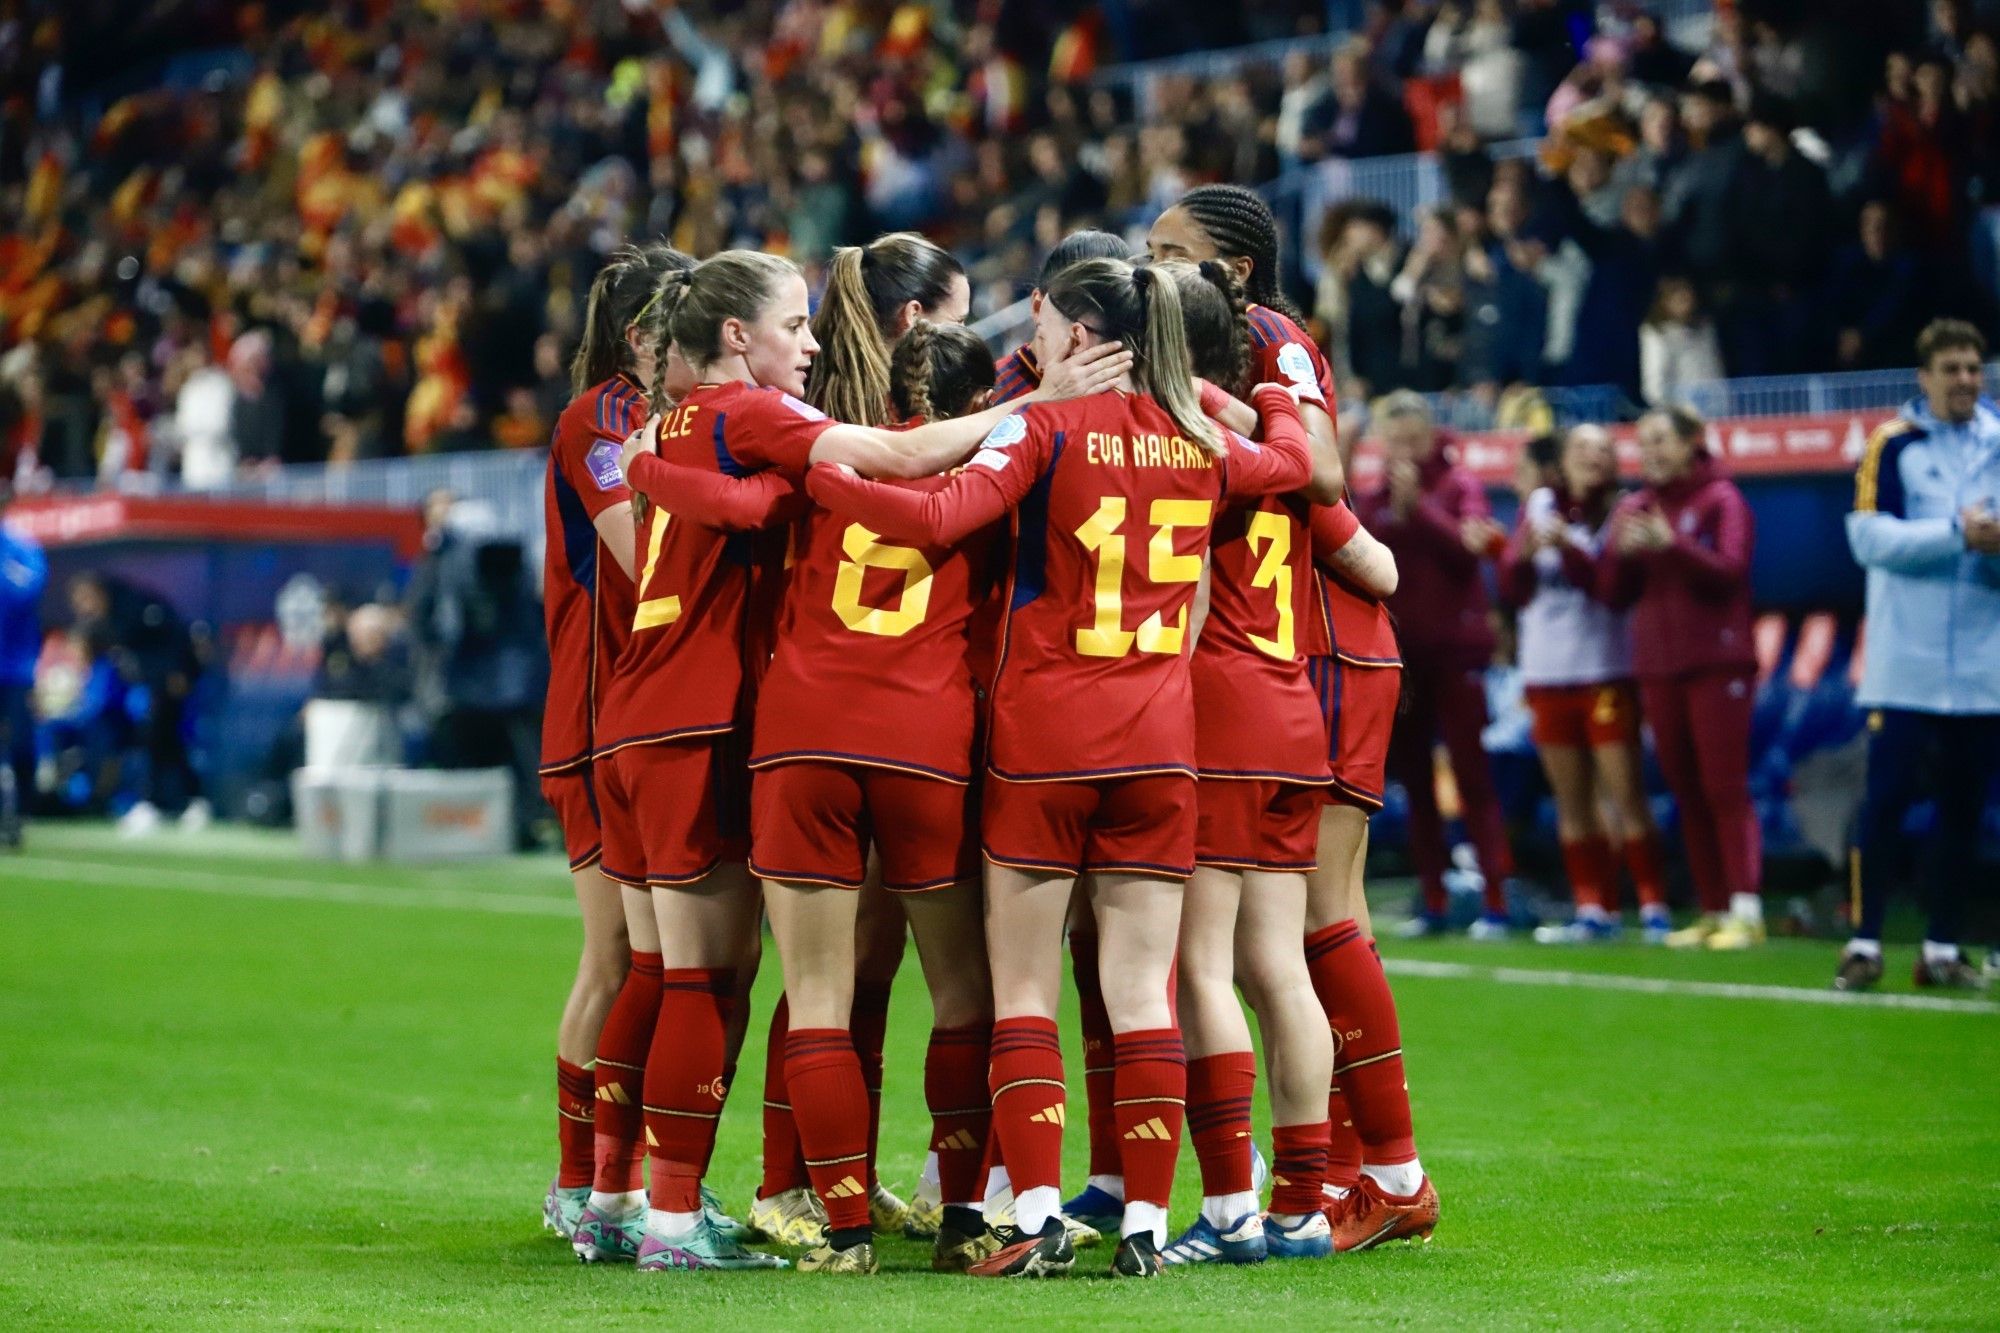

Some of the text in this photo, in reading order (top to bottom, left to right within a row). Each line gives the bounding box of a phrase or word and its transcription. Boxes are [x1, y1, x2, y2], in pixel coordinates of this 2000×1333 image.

[1087, 432, 1125, 467] EVA
[1074, 496, 1212, 657] 15
[1246, 511, 1296, 662] 3
[696, 1083, 709, 1094] 19
